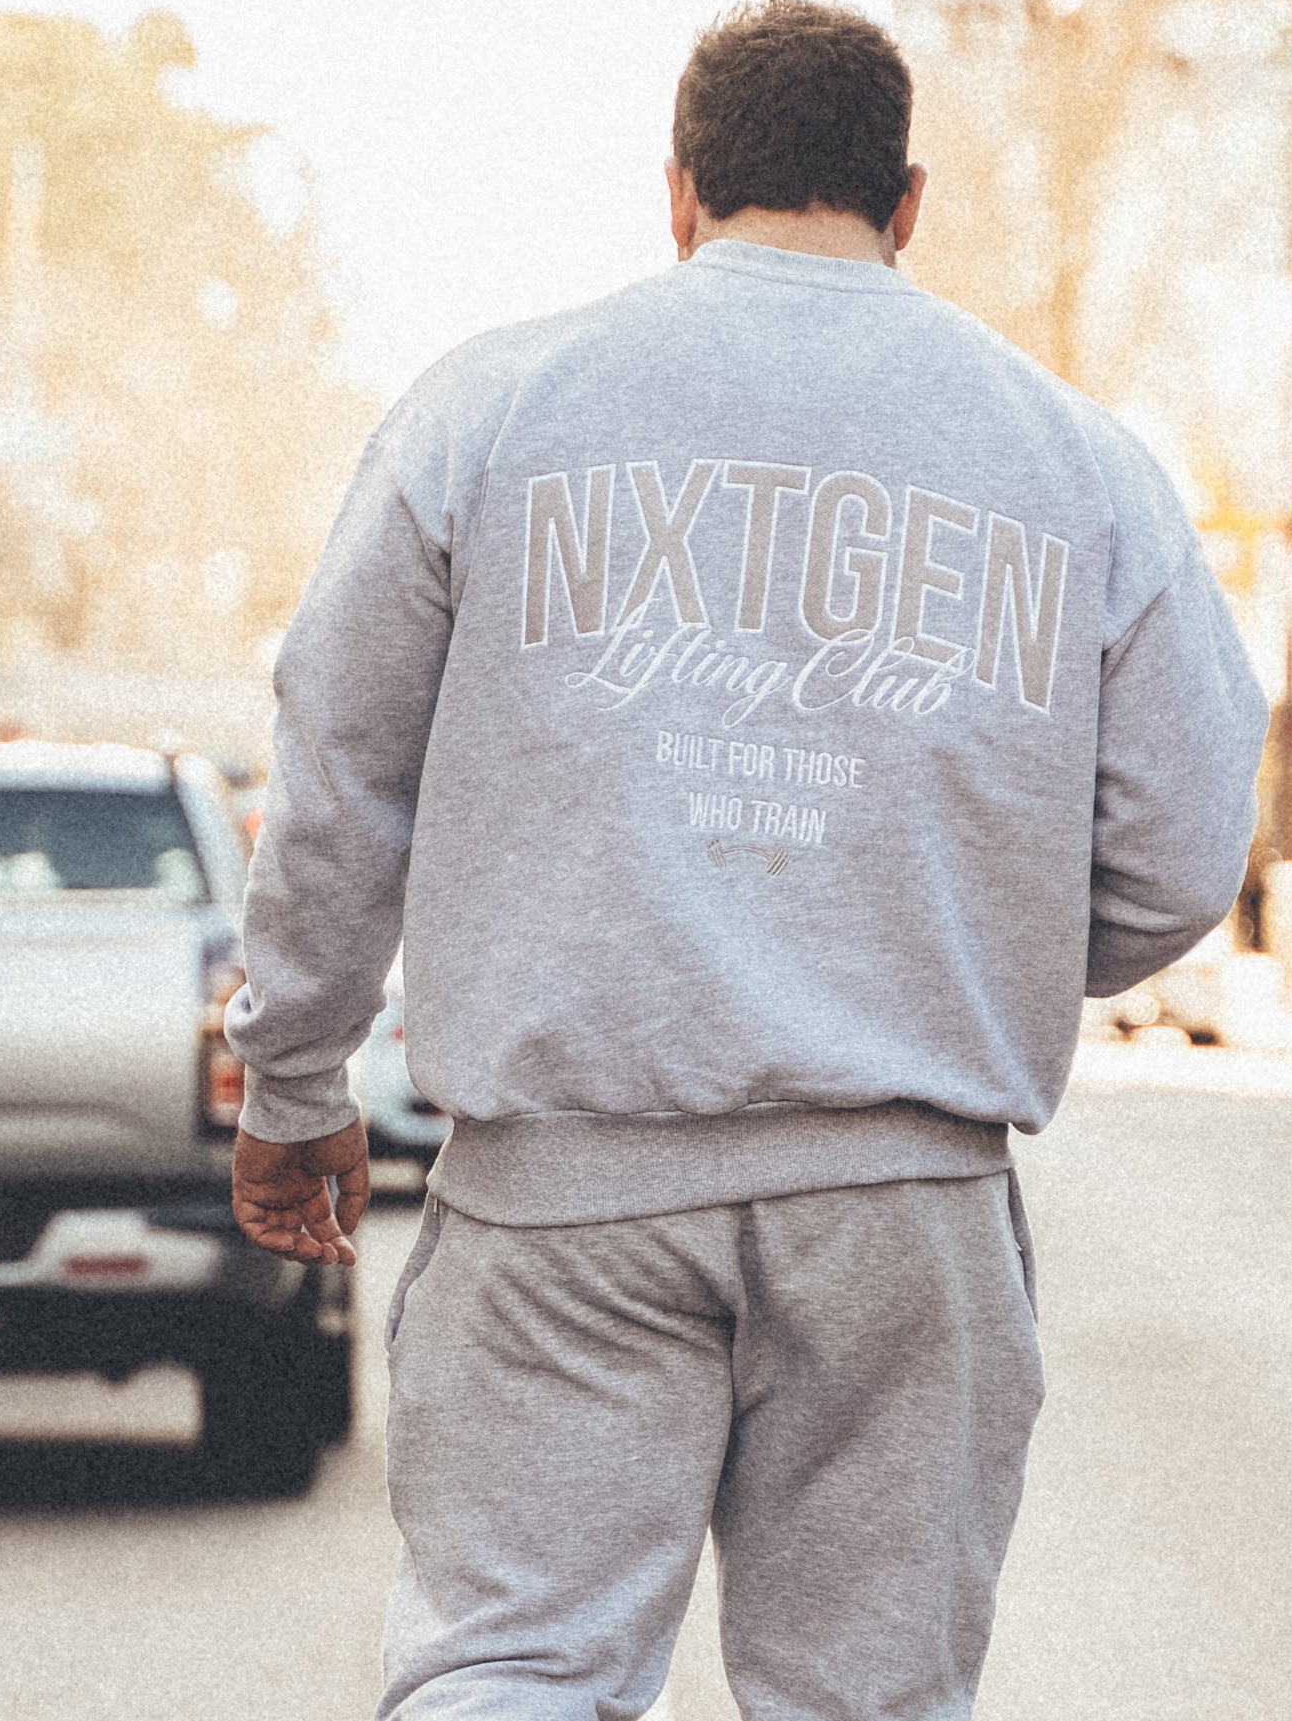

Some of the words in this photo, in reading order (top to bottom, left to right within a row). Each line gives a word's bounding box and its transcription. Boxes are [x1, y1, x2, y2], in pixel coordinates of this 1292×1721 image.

[520, 458, 1071, 716] NXTGEN
[564, 598, 795, 729] Lifting
[792, 629, 977, 716] Club
[656, 730, 725, 773] BUILT
[727, 741, 776, 780] FOR
[782, 747, 866, 789] THOSE
[689, 791, 744, 831] WHO
[750, 800, 827, 844] TRAIN
